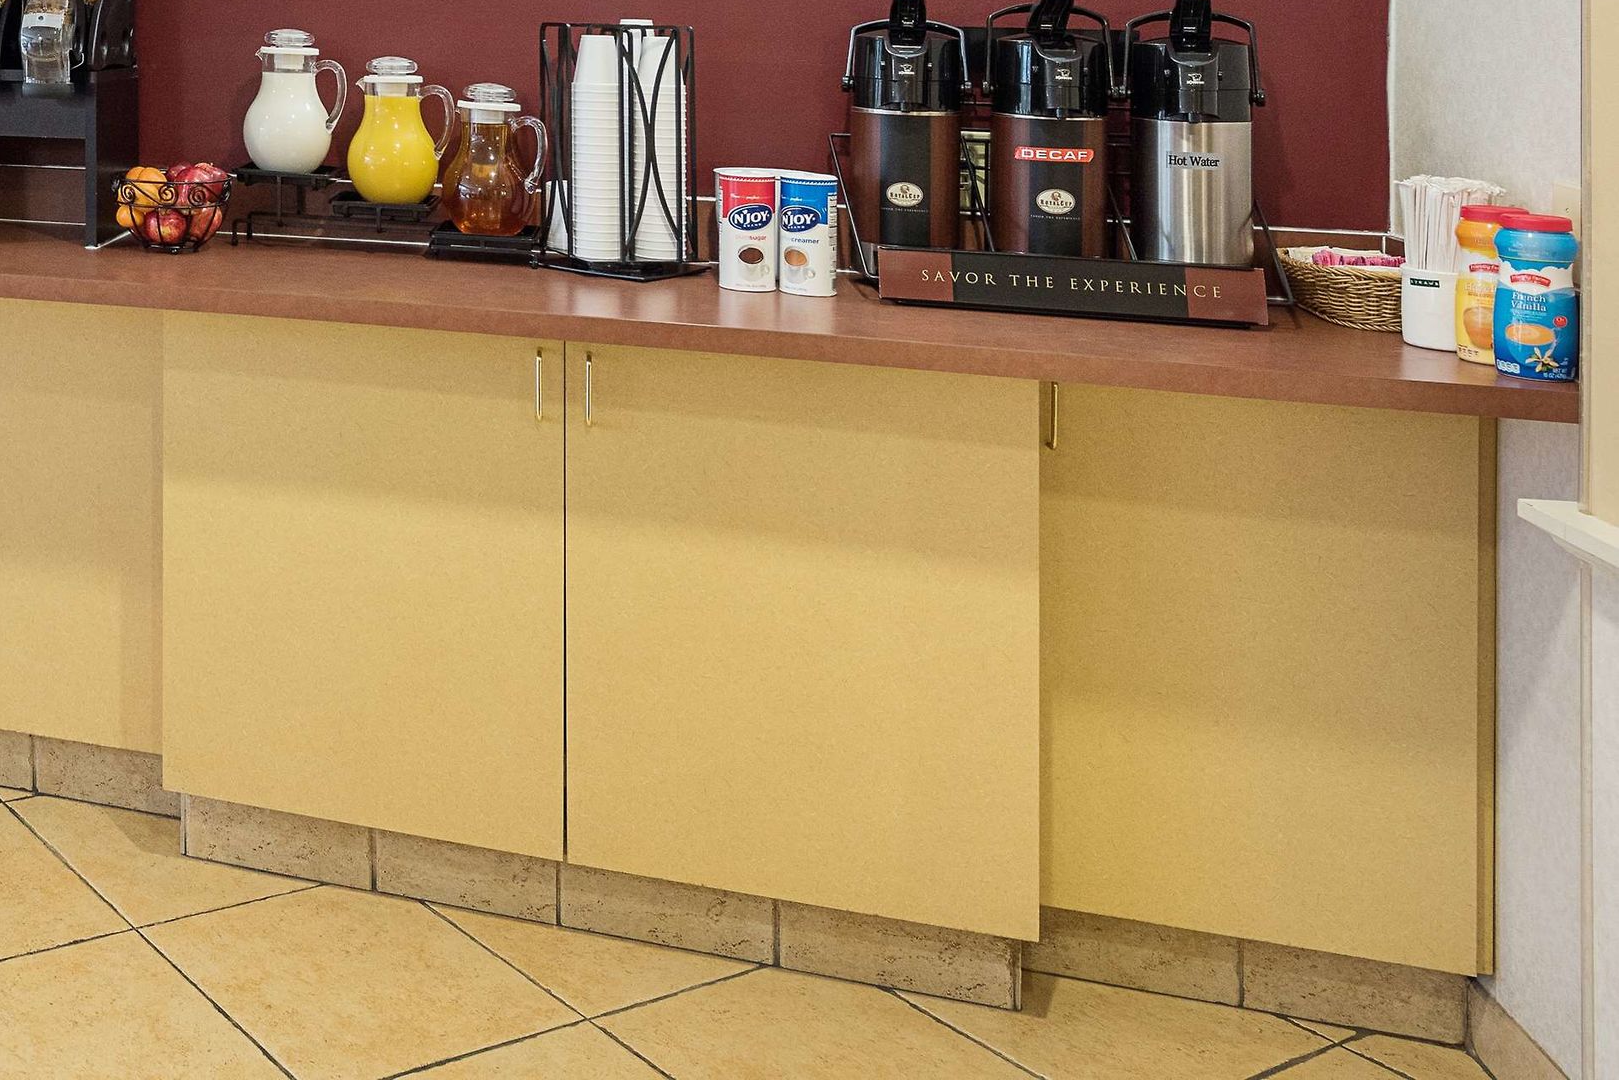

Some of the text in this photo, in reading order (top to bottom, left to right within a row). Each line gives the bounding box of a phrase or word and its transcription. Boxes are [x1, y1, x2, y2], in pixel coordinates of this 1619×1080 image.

[1021, 148, 1088, 161] DECAF
[1168, 154, 1220, 167] Hot Water
[791, 237, 820, 245] creamer
[922, 269, 1221, 299] SAVOR THE EXPERIENCE
[1512, 291, 1546, 303] French
[1512, 300, 1547, 312] Vanilla
